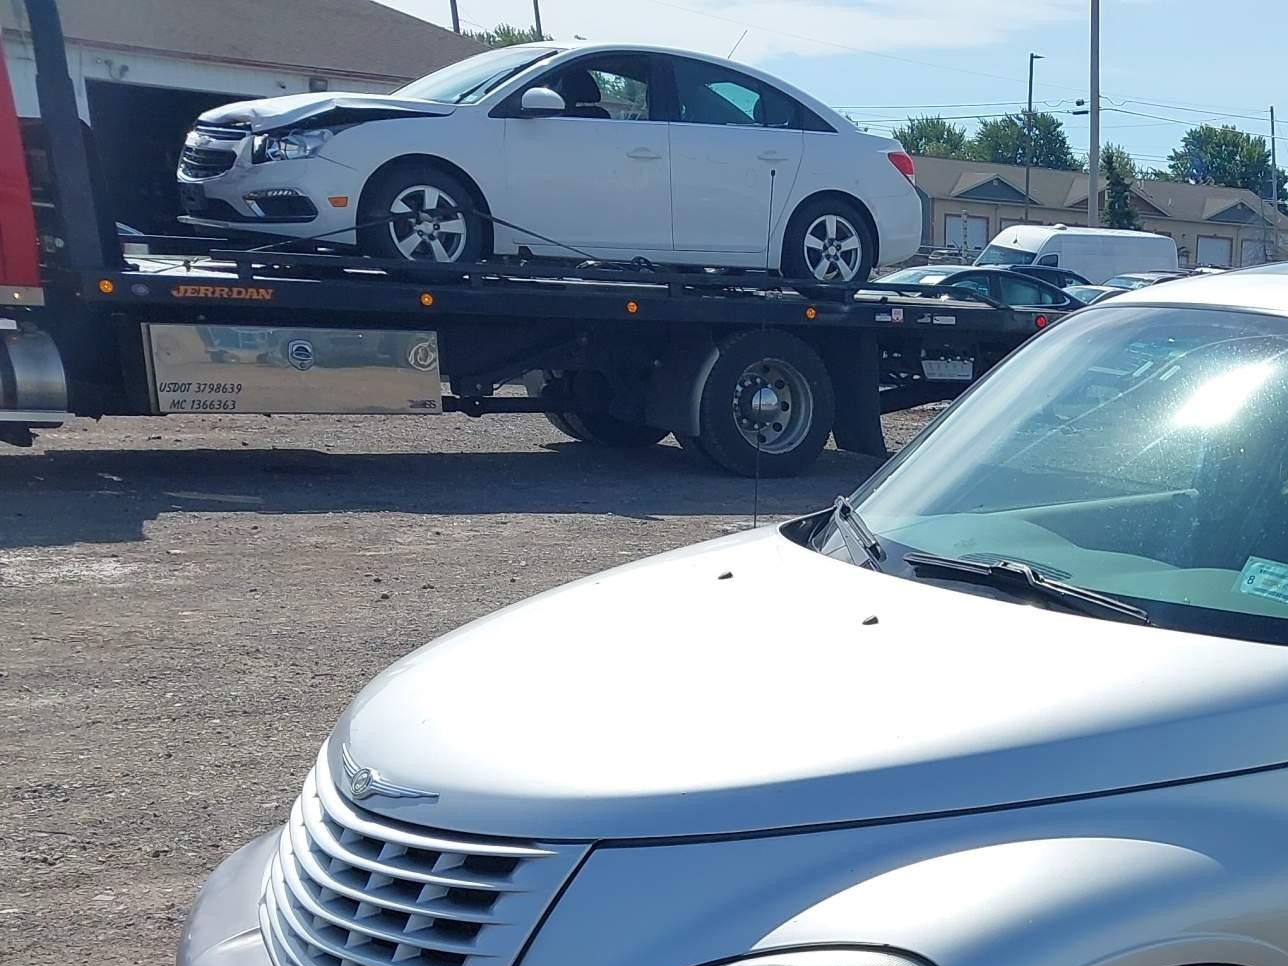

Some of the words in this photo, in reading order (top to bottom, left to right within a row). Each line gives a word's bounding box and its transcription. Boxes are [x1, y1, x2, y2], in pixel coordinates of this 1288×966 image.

[160, 382, 193, 393] USDOT
[194, 383, 242, 394] 3798639
[169, 399, 187, 410] MC
[190, 399, 237, 410] 1366363
